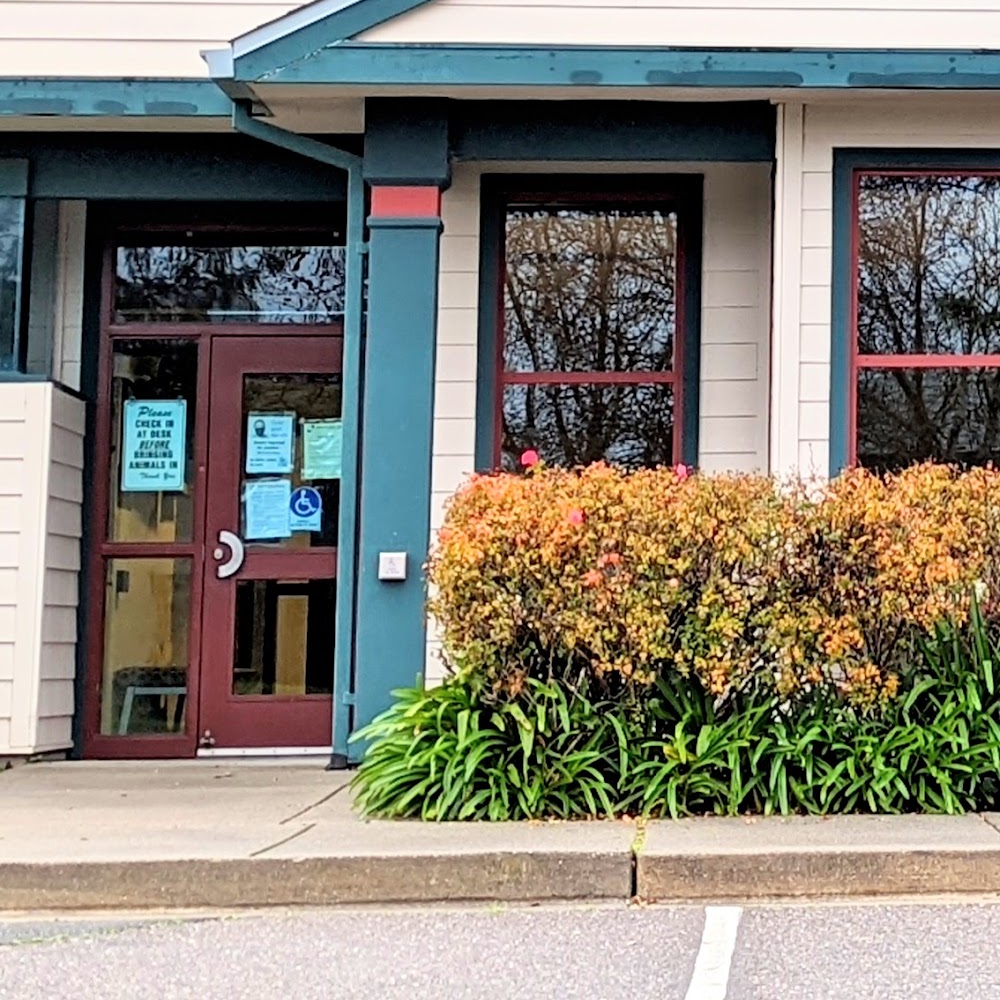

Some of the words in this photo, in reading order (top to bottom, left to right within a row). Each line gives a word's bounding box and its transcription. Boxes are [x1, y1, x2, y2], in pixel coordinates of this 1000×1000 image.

[138, 405, 172, 417] Please
[135, 419, 161, 428] CHECK
[165, 419, 174, 428] IN
[137, 430, 147, 438] AT
[150, 430, 172, 438] DESK
[139, 440, 170, 449] BEFORE
[134, 450, 173, 458] BRINGING
[129, 461, 165, 469] ANIMALS
[169, 461, 178, 469] IN
